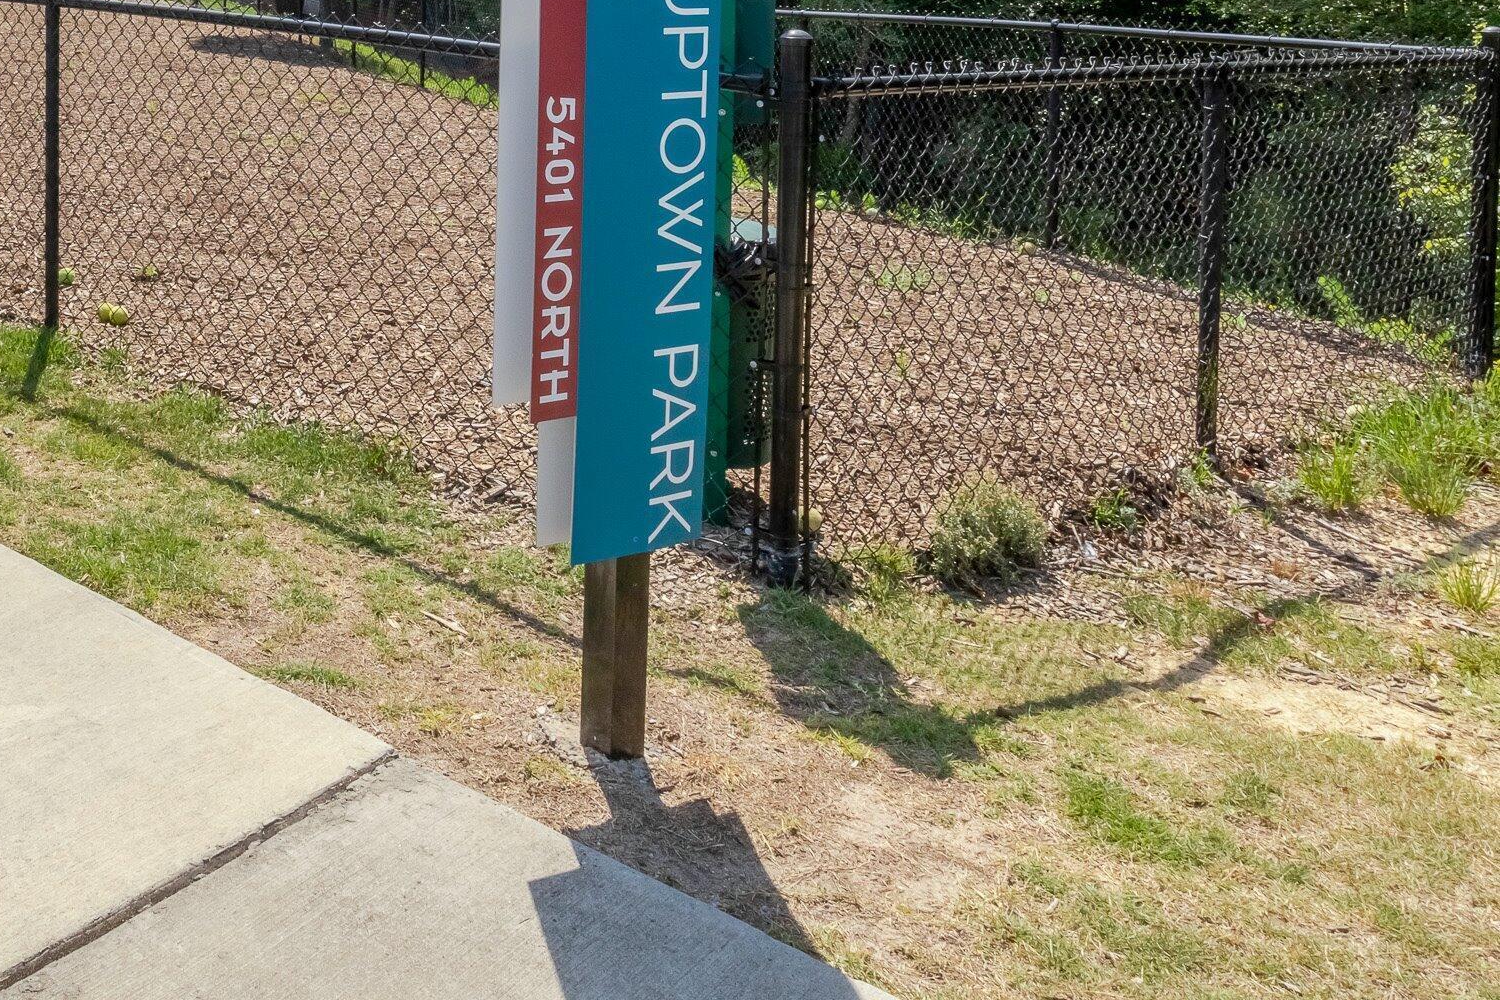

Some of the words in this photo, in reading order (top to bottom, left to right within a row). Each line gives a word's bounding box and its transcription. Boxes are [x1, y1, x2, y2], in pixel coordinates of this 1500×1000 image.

[544, 96, 576, 203] 5401
[539, 226, 573, 404] NORTH
[648, 343, 699, 545] PARK
